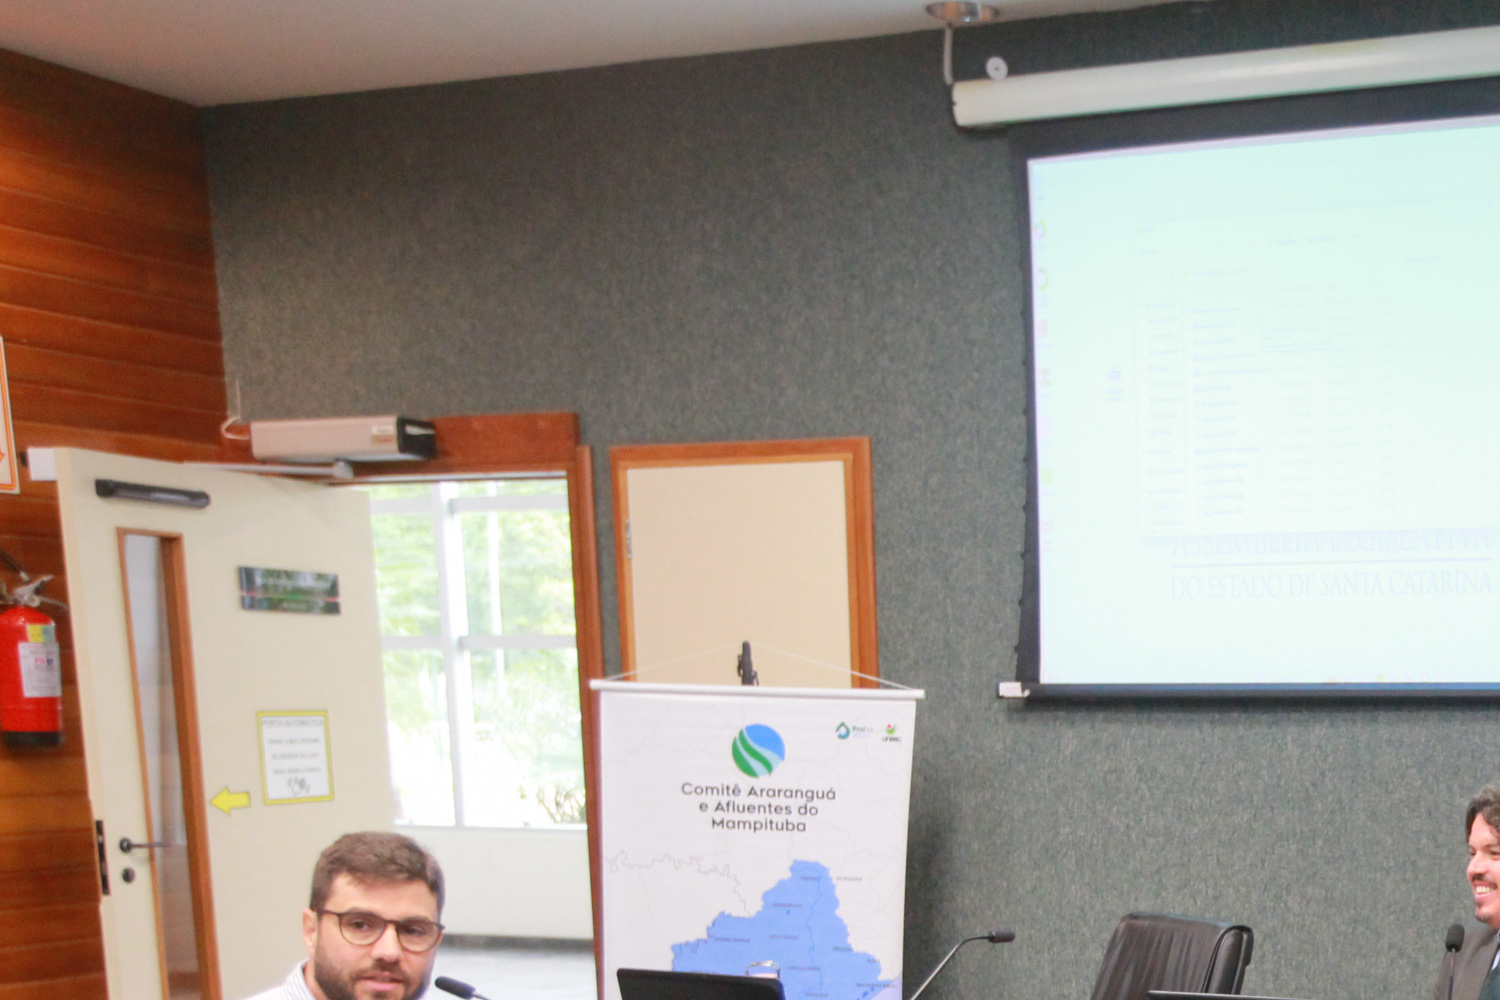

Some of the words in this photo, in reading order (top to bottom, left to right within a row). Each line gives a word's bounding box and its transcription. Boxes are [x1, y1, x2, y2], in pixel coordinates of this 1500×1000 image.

[1170, 575, 1203, 600] DO
[1207, 573, 1283, 599] ESTADO
[1287, 572, 1315, 597] DE
[1319, 571, 1385, 597] SANTA
[1387, 569, 1494, 595] CATARINA
[681, 782, 742, 797] Comitê
[747, 786, 836, 802] Araranguá
[699, 801, 709, 813] e
[714, 801, 792, 815] Afluentes
[797, 803, 819, 816] do
[711, 817, 806, 833] Mampituba
